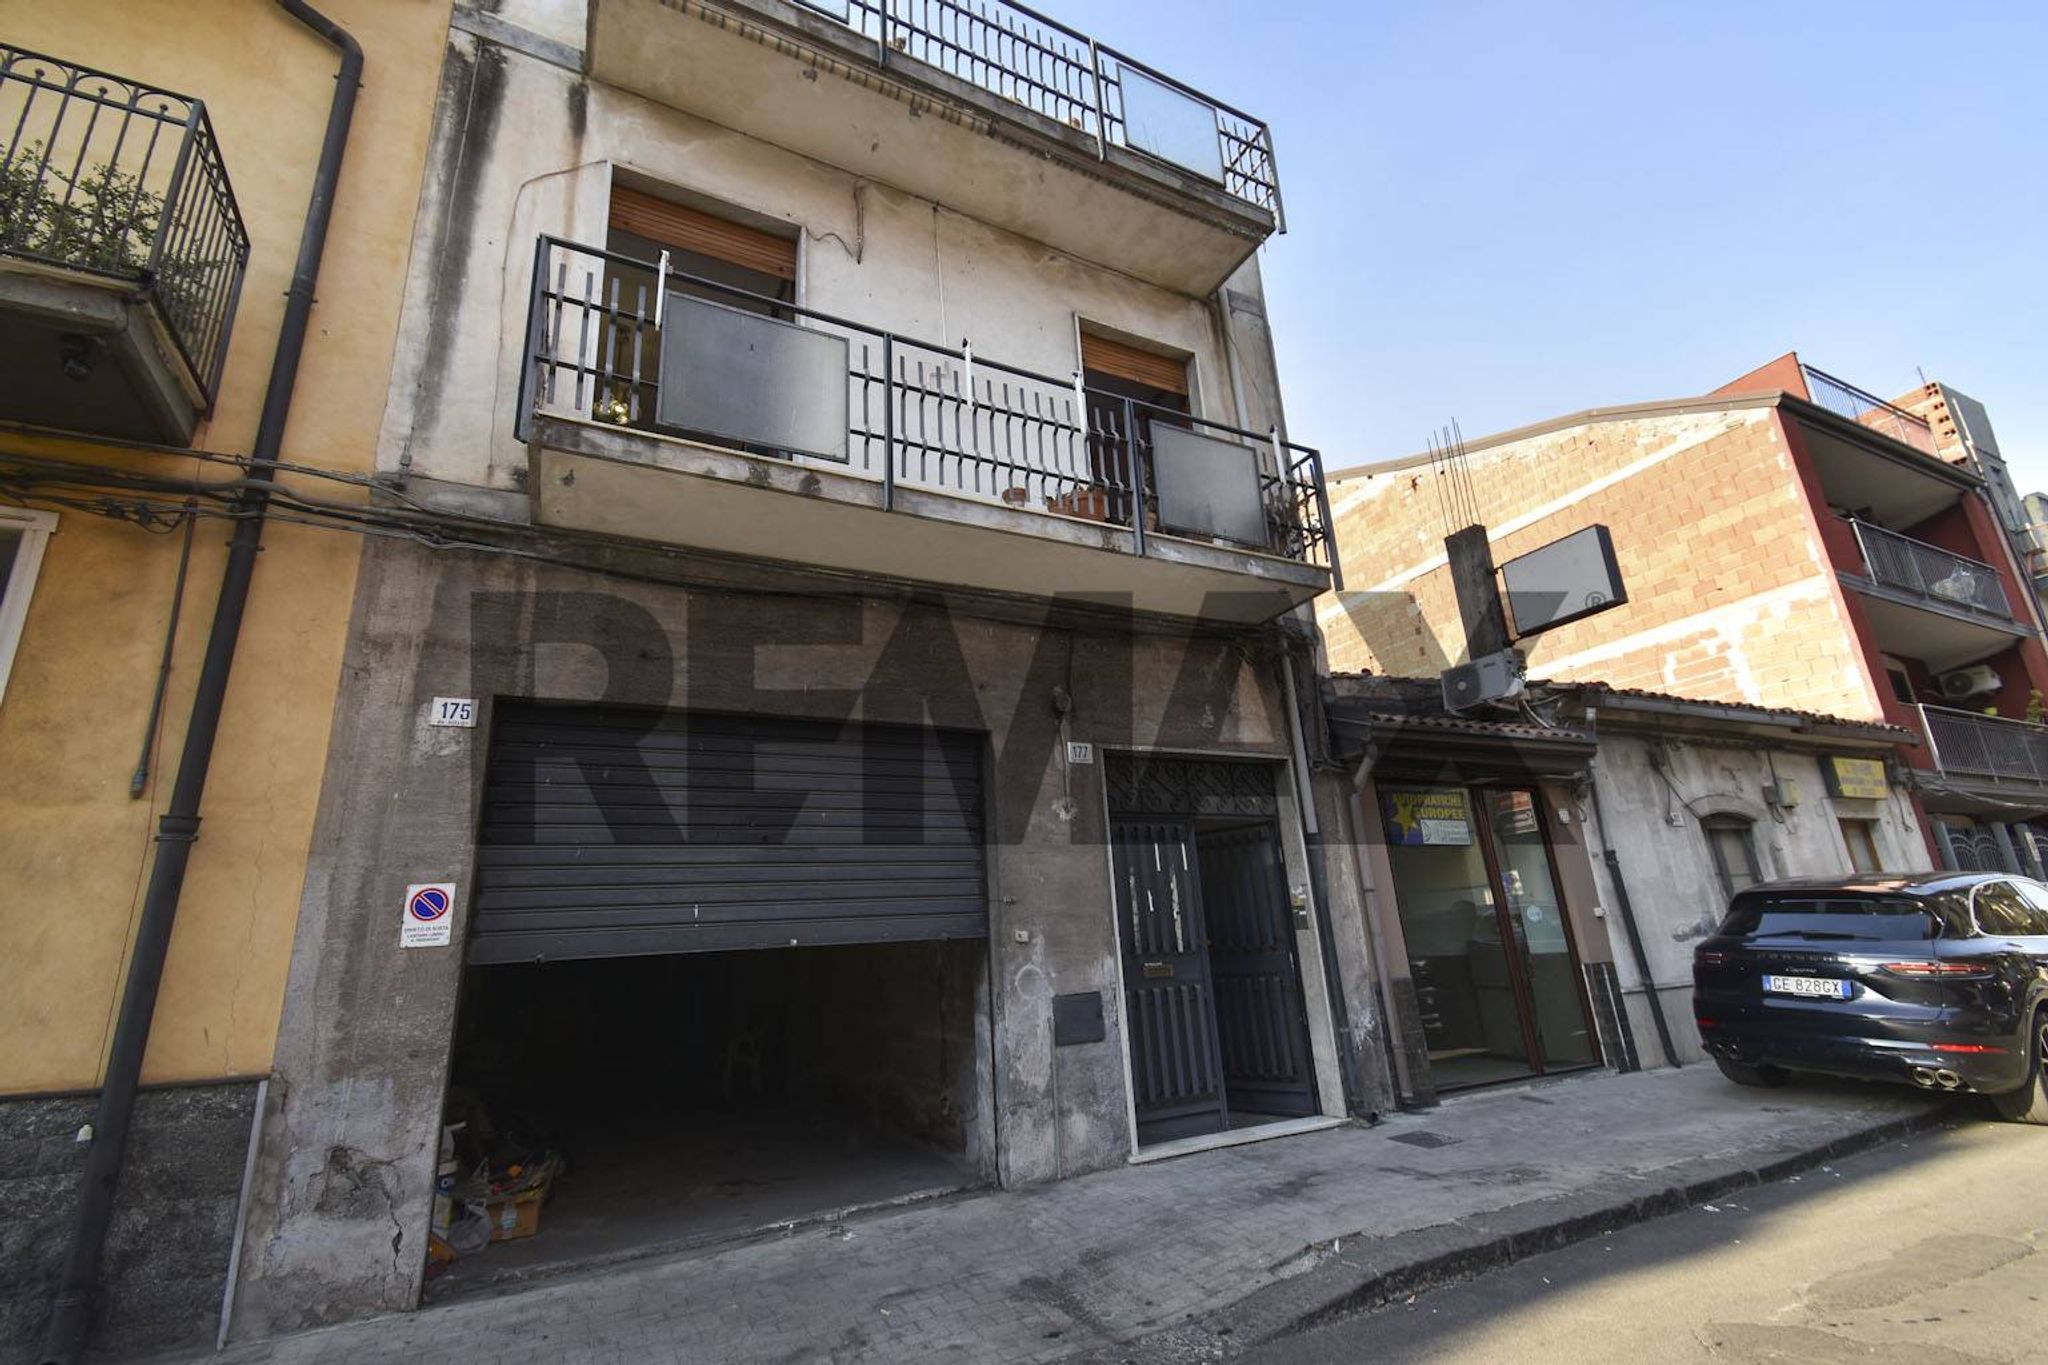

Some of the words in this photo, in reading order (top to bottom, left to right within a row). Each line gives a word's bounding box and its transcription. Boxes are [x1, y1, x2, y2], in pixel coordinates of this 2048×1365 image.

[441, 702, 471, 720] 175
[1072, 745, 1088, 759] 177
[1773, 977, 1791, 991] GE
[1795, 978, 1840, 995] 828GX
